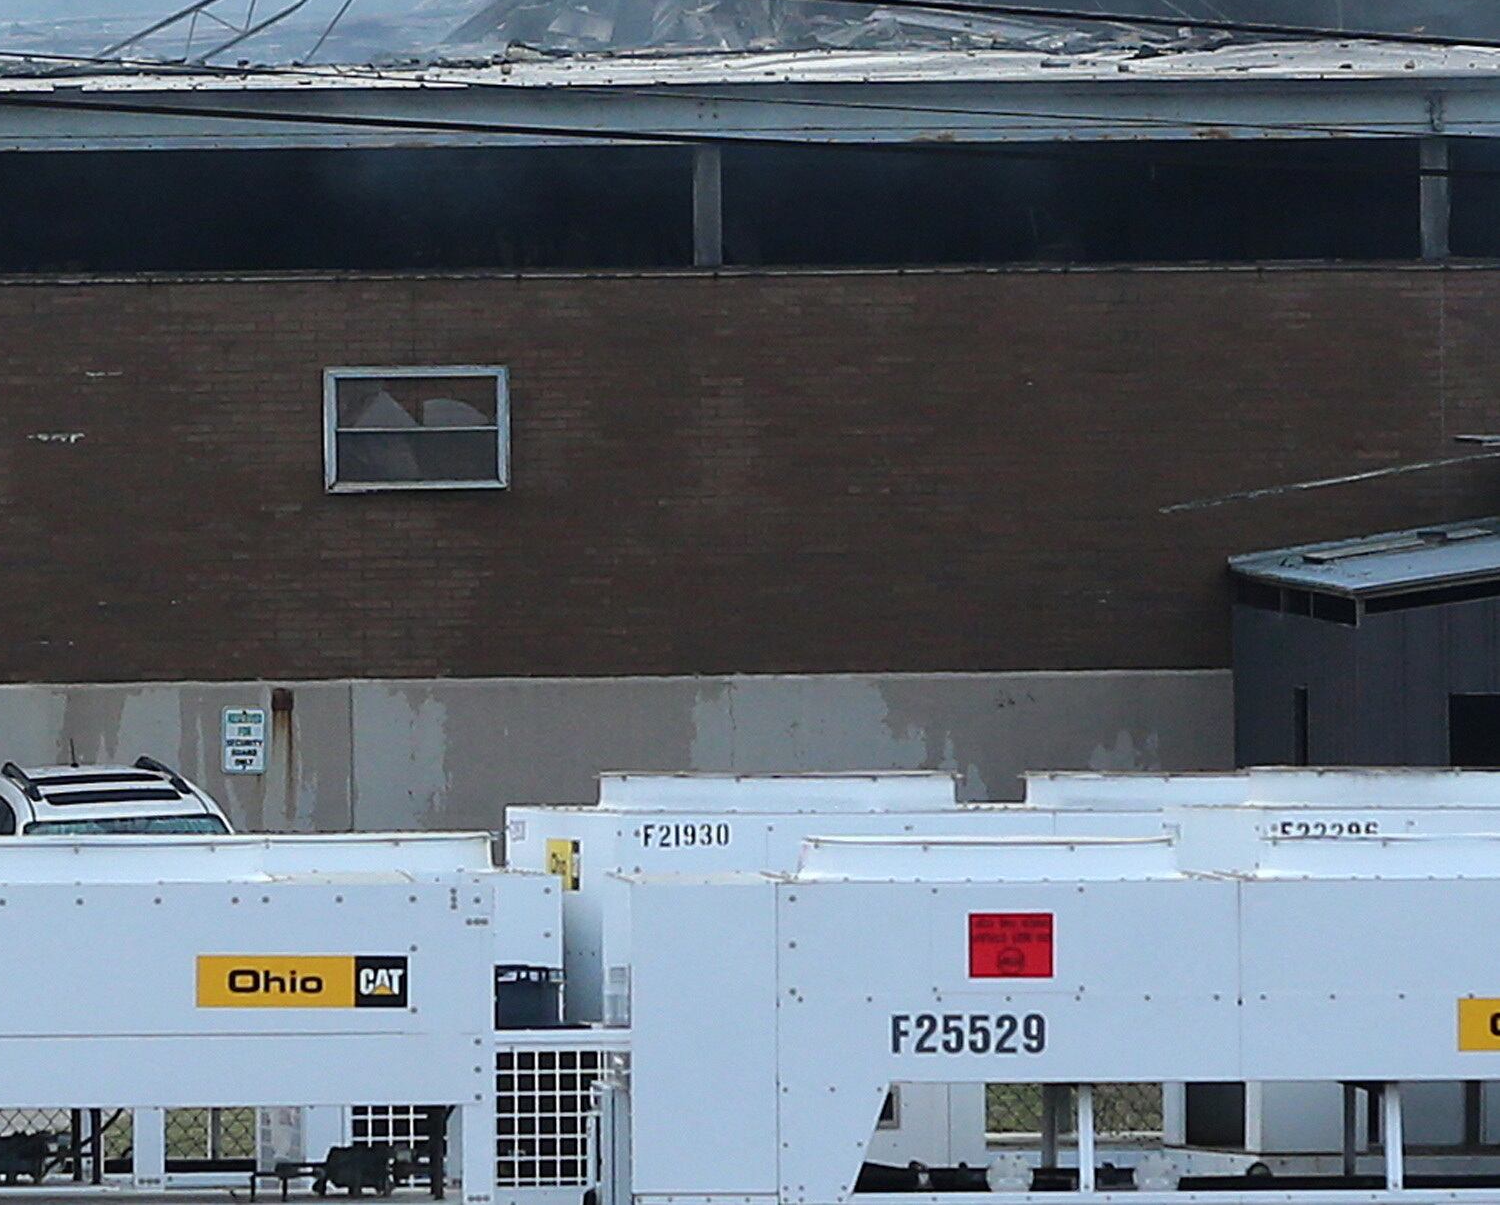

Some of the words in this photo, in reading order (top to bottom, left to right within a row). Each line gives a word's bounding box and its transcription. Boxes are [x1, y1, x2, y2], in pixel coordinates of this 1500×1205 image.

[643, 822, 730, 847] F21930
[227, 969, 324, 994] Ohio
[359, 968, 405, 995] CAT
[890, 1013, 1046, 1054] F25529
